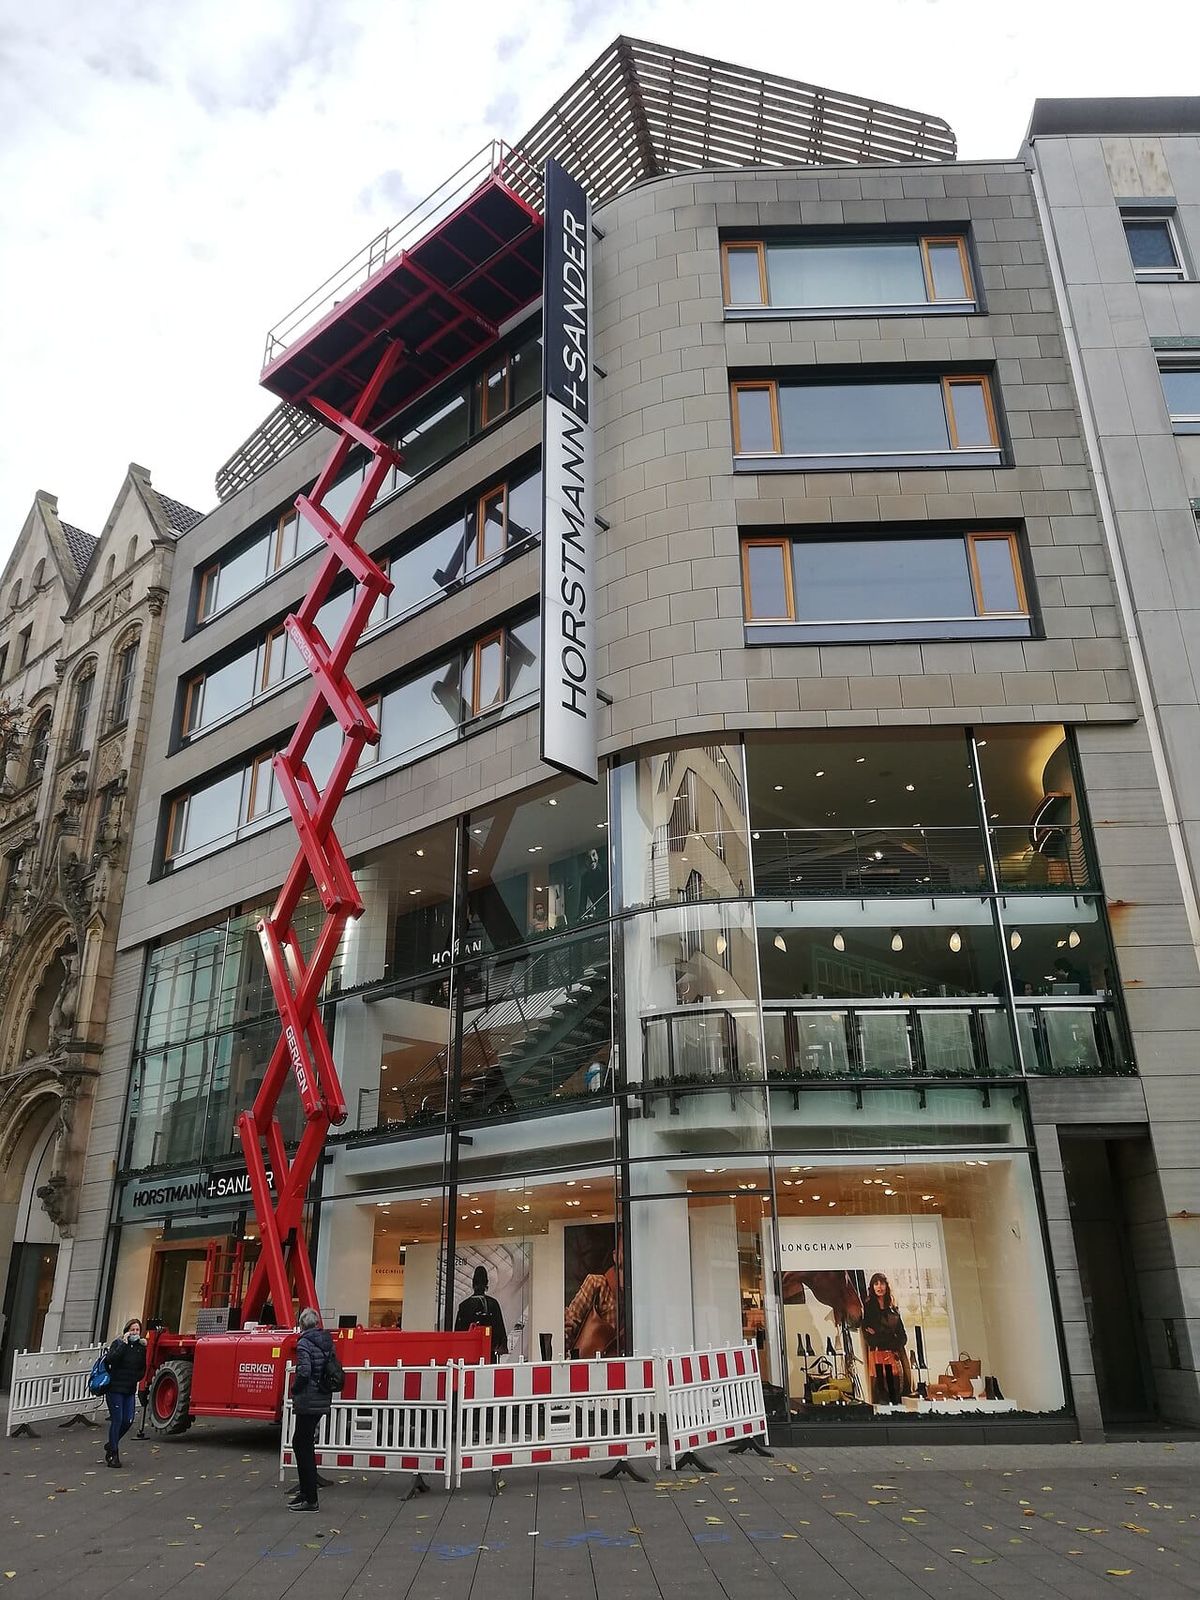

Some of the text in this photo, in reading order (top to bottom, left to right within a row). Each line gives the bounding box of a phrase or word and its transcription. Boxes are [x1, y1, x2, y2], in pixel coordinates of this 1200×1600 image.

[285, 1024, 309, 1095] GERKEN
[781, 1243, 852, 1252] LONGCHAMP
[239, 1363, 275, 1373] GERKEN
